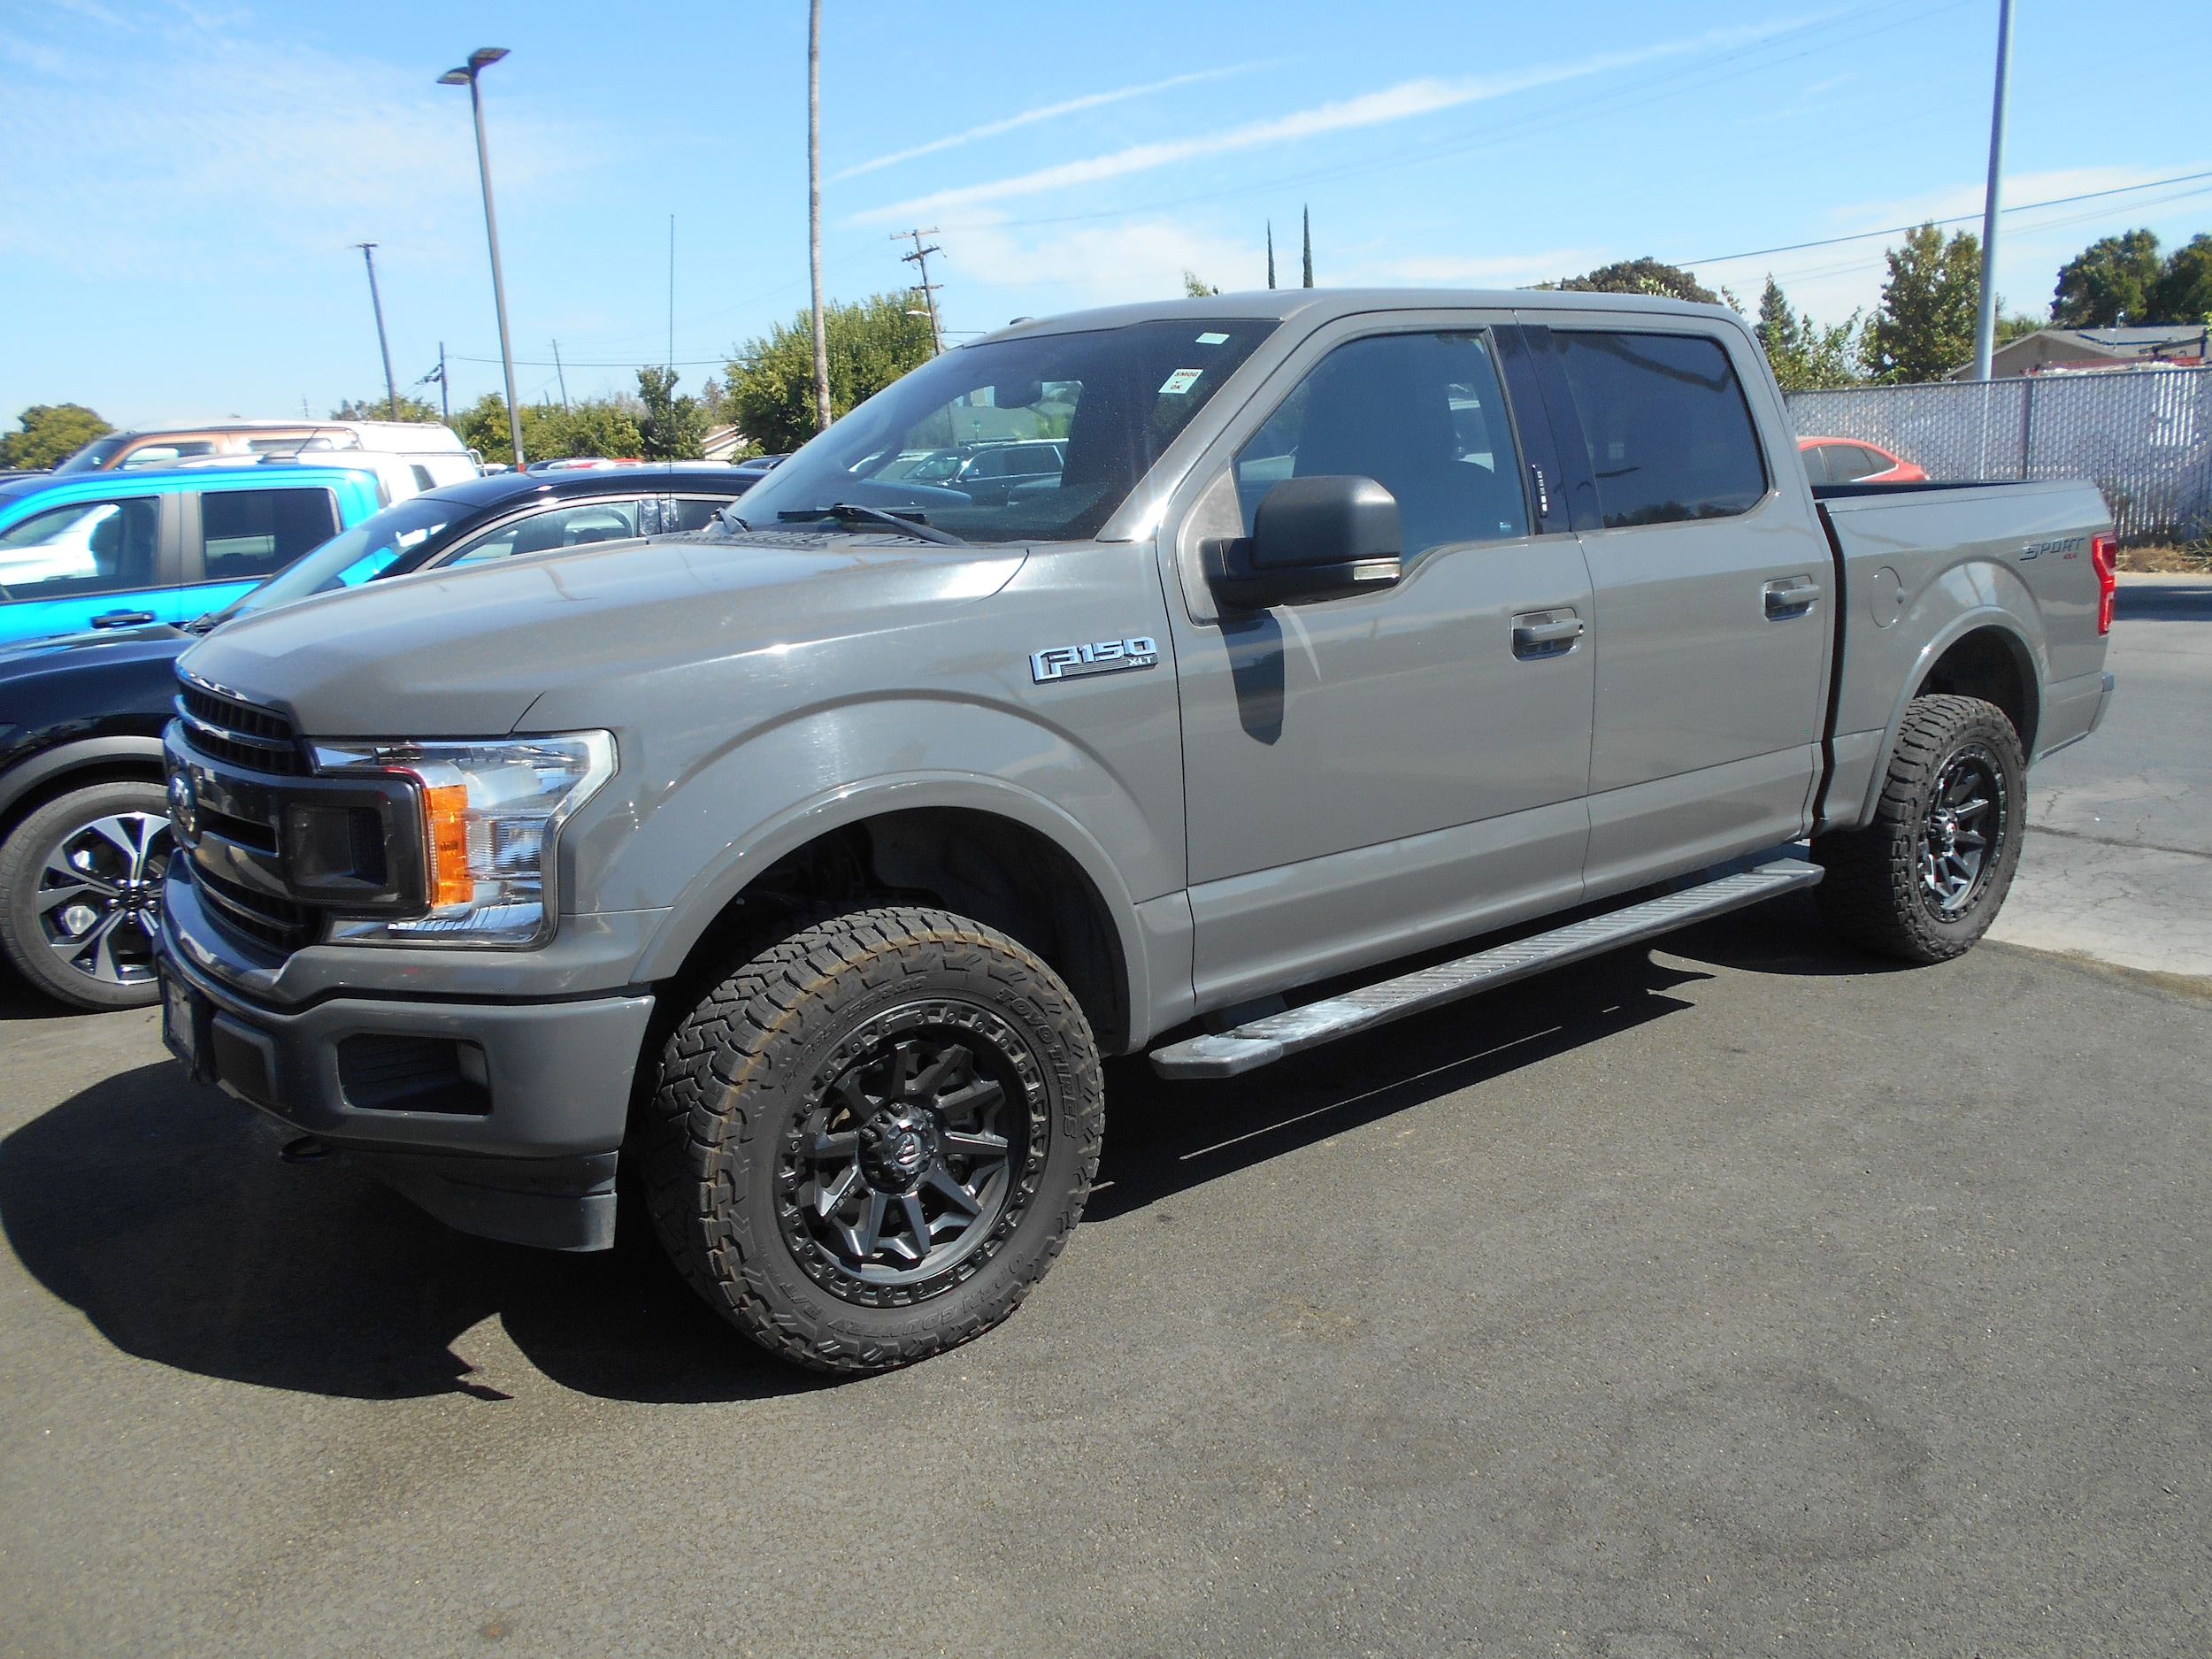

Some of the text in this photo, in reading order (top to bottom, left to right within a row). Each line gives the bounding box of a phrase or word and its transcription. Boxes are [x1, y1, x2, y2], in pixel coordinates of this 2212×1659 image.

[2019, 537, 2085, 561] SPORT
[1128, 656, 1153, 665] XLT
[996, 987, 1078, 1139] TOYO TIRES
